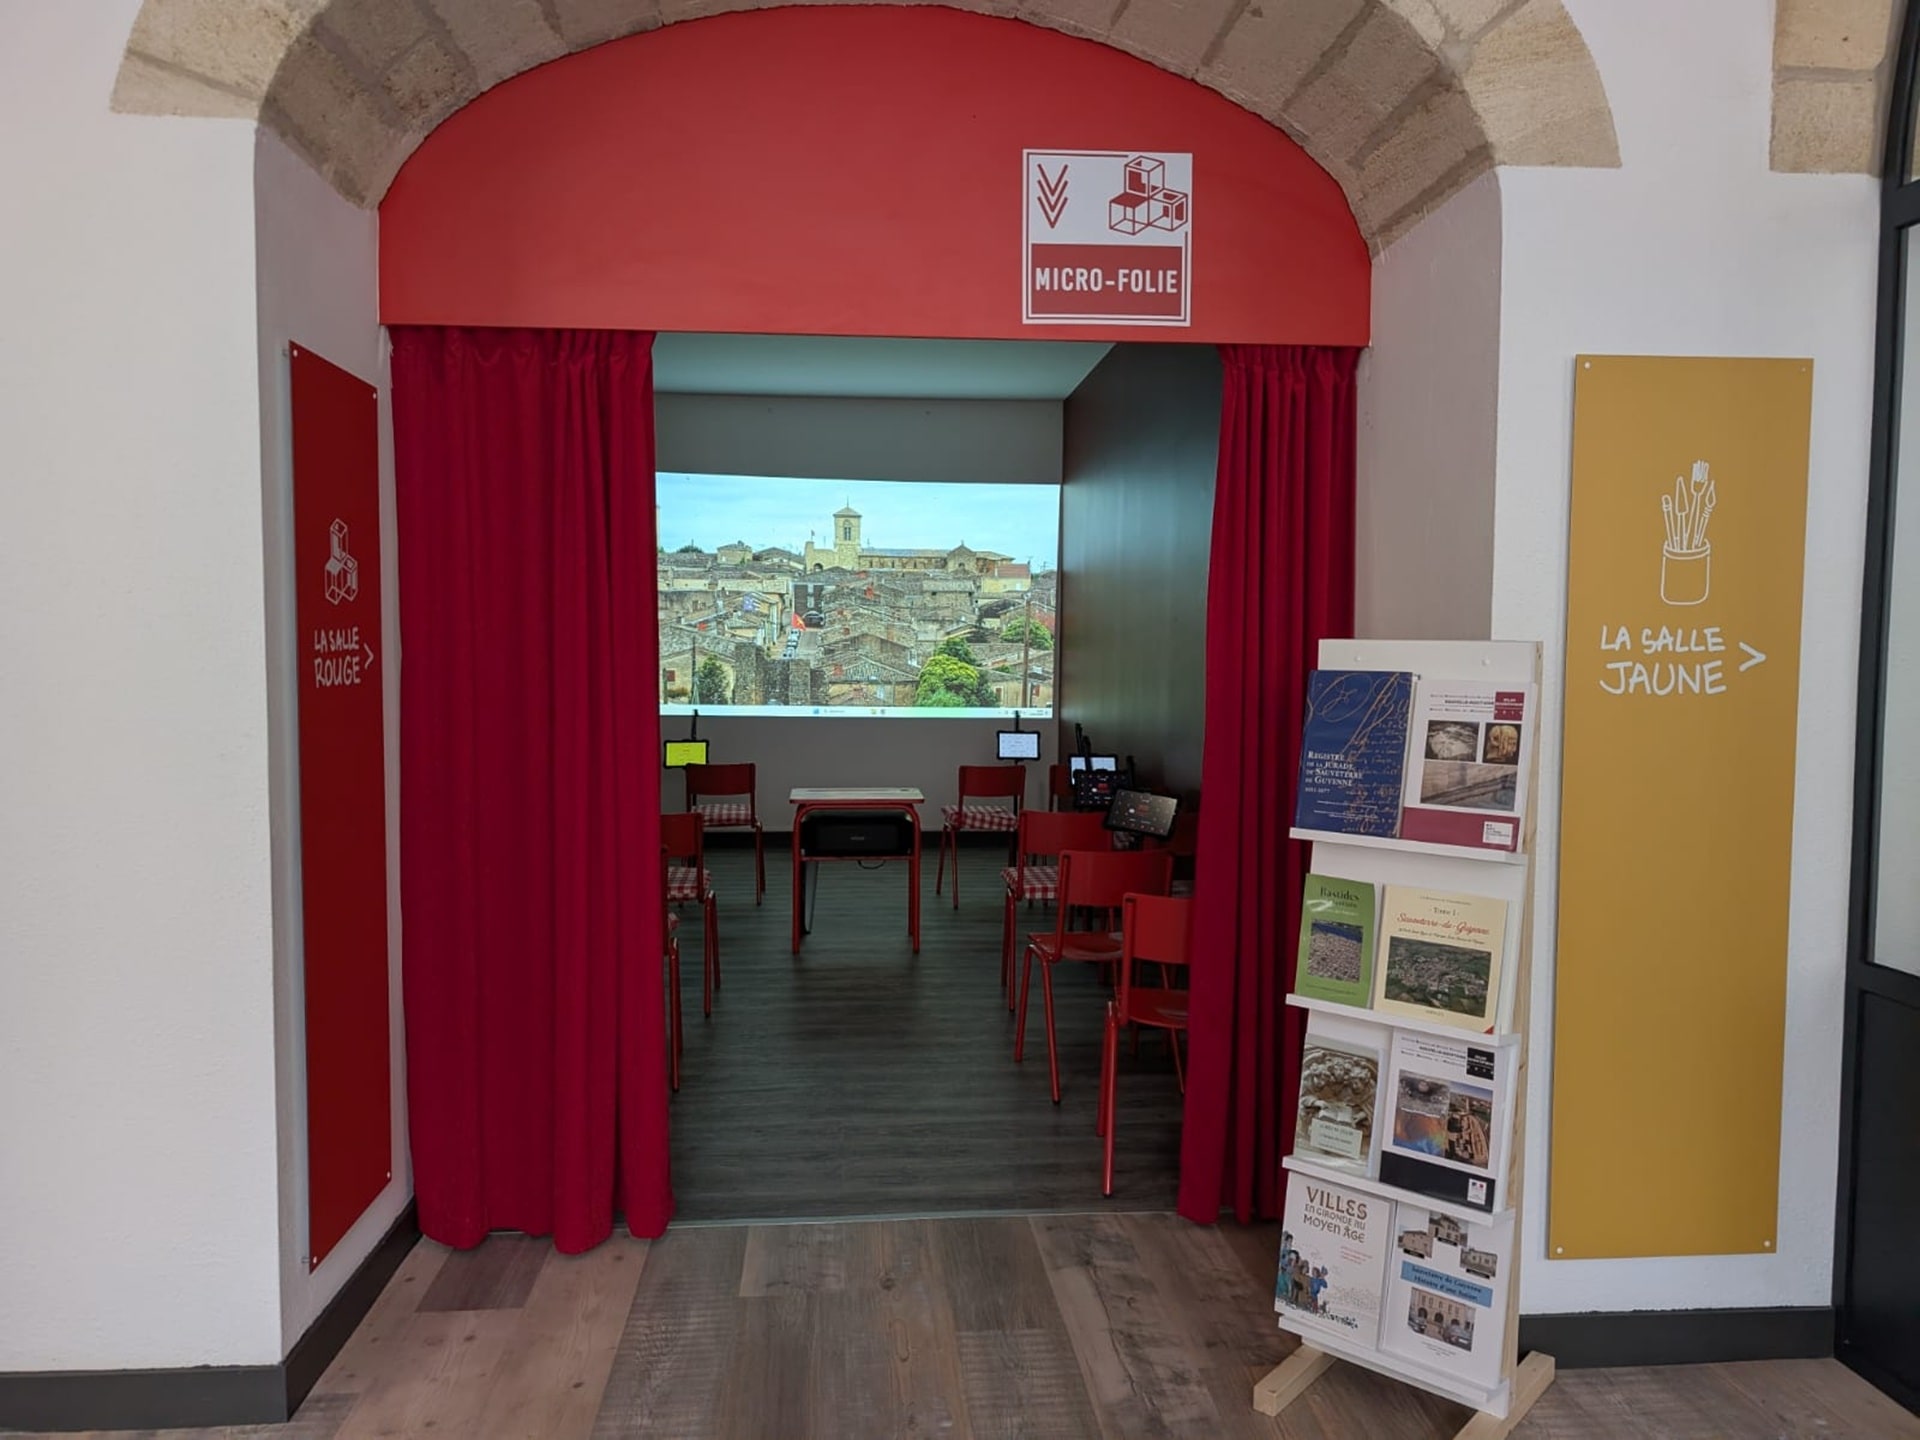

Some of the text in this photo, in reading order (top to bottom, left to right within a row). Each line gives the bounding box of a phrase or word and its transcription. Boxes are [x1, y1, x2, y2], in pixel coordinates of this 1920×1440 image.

[1035, 267, 1178, 293] MICRO-FOLIE
[313, 626, 359, 653] LA SALLE
[1601, 625, 1726, 654] LA SALLE
[314, 655, 361, 688] ROUGE
[1599, 660, 1727, 695] JAUNE
[1306, 1186, 1367, 1220] VILLES
[1316, 1207, 1353, 1226] GIRONDE
